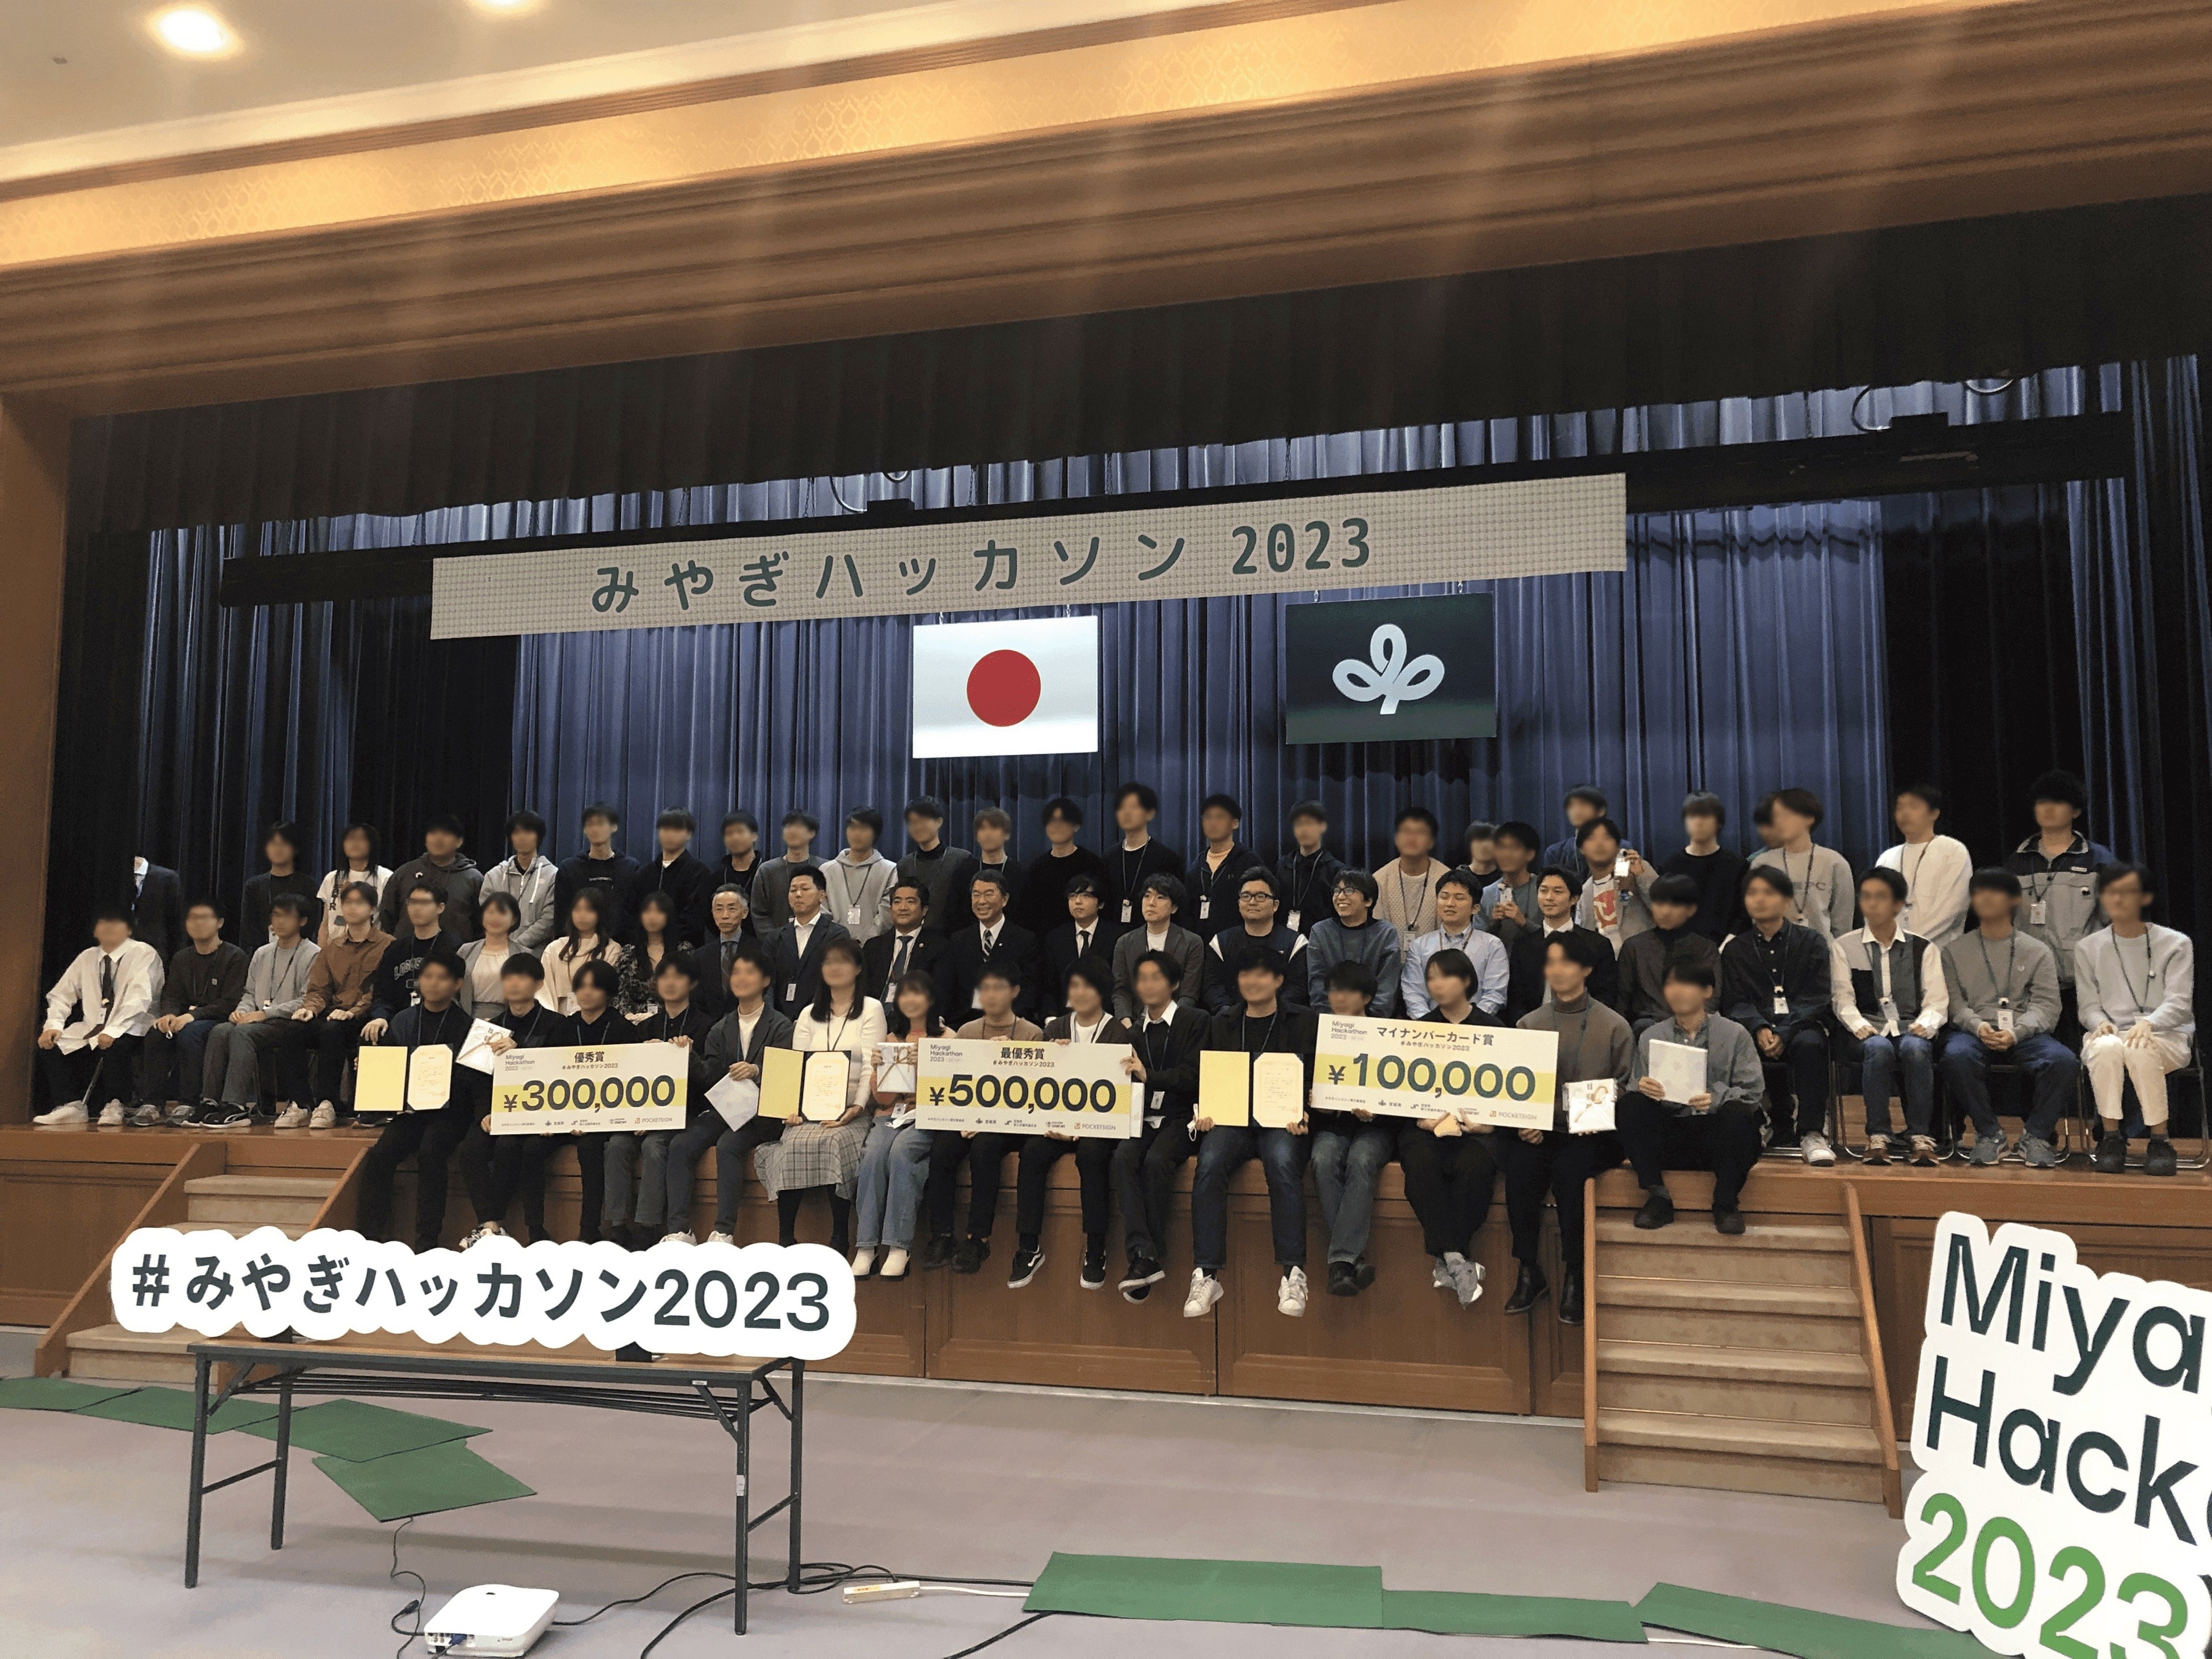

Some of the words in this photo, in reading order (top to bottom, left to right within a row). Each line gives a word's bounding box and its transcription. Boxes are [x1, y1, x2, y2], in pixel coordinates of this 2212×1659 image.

[591, 534, 1185, 614] みやぎハッカソン
[1232, 518, 1370, 575] 2023
[1001, 1047, 1045, 1060] 最優秀賞
[1377, 1026, 1494, 1046] マイナンバーカード賞
[574, 1051, 605, 1063] 優秀賞
[1328, 1053, 1535, 1101] ¥100,000
[504, 1075, 676, 1113] ¥300,000
[929, 1074, 1117, 1114] ¥500,000
[1498, 1112, 1537, 1120] POCKETSIGN
[132, 1253, 829, 1331] #みやぎハッカソン2023
[1926, 1354, 2212, 1547] Hack
[1912, 1493, 2188, 1659] 2023
